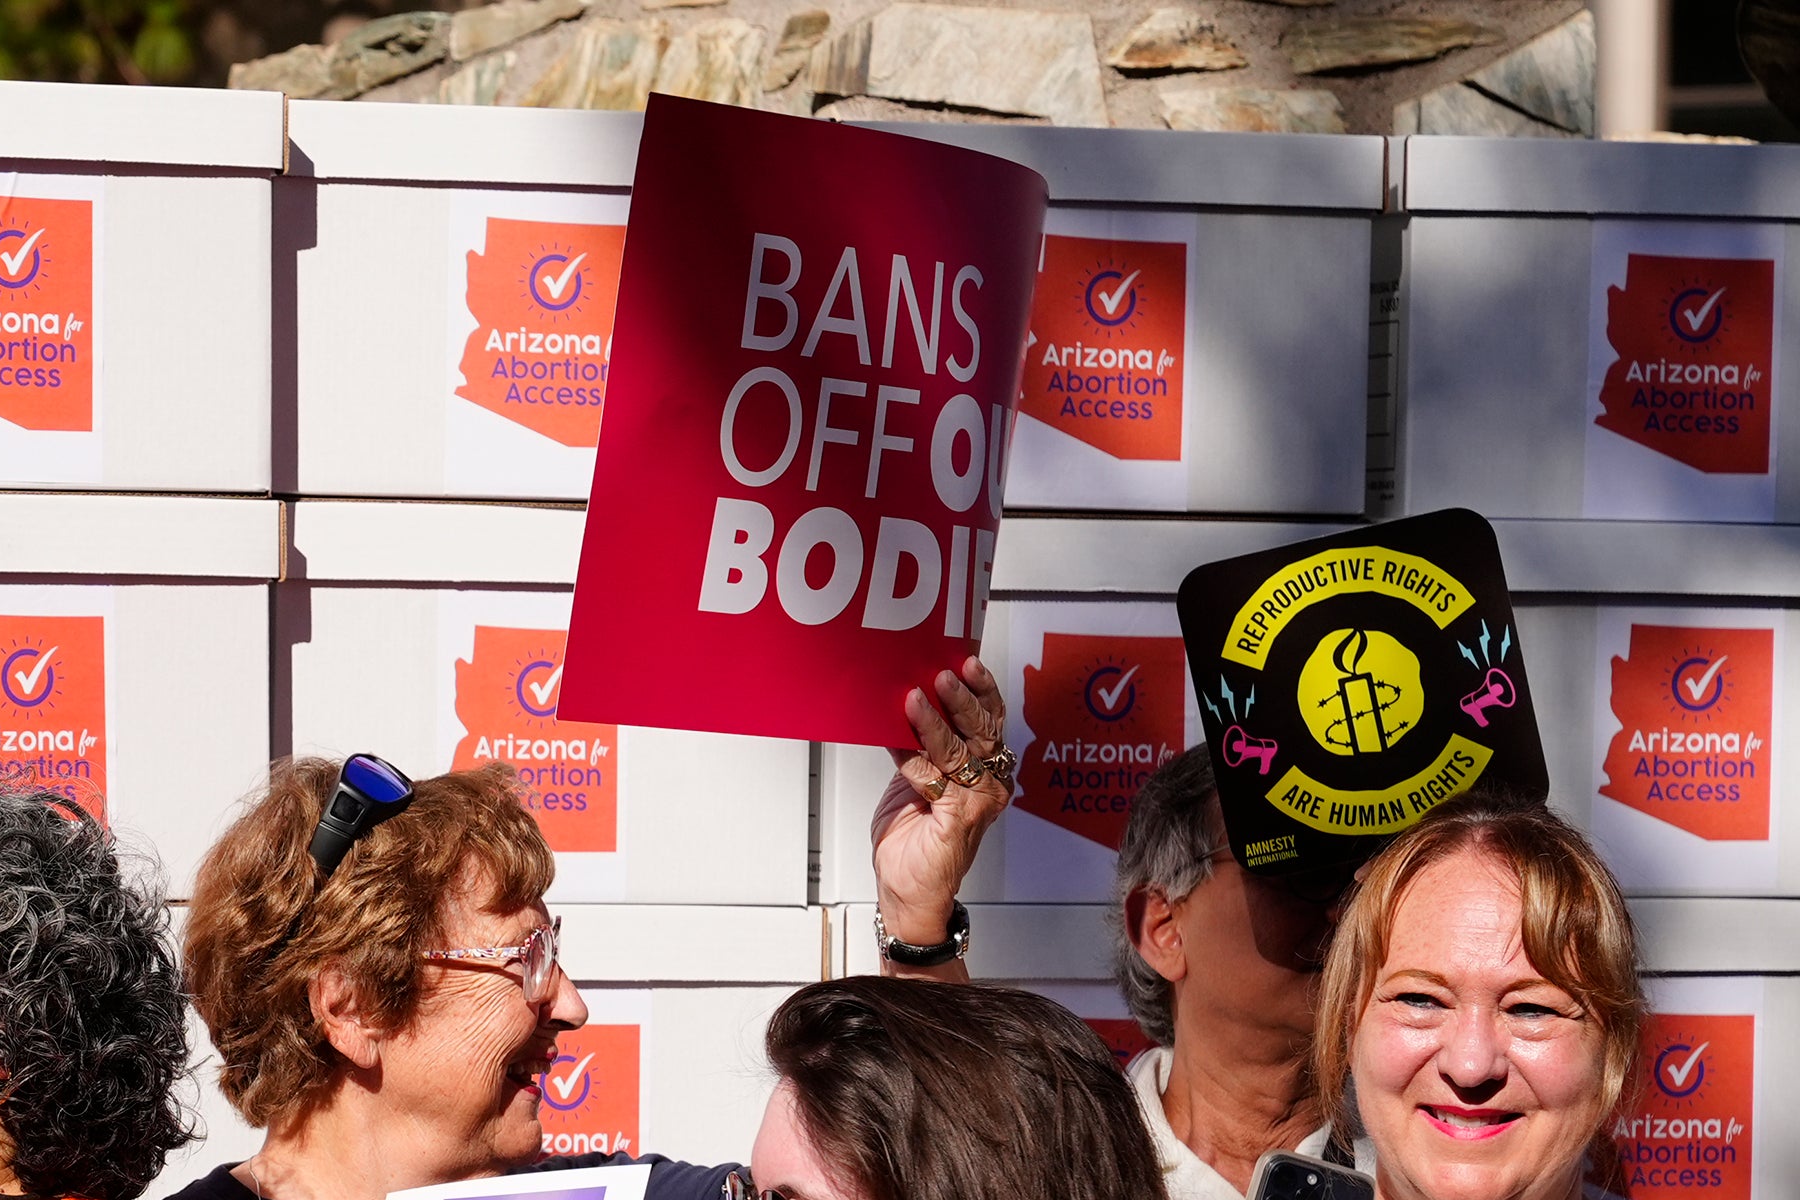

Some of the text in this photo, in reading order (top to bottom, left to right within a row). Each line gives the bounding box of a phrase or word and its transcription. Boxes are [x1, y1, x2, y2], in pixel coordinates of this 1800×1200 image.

[741, 232, 984, 383] BANS
[64, 312, 84, 341] for
[485, 326, 600, 355] Arizona
[1042, 341, 1175, 376] Arizona for
[1048, 370, 1167, 396] Abortion
[1625, 358, 1762, 390] Arizona for
[505, 383, 602, 406] Access
[1060, 396, 1153, 420] Access
[1631, 386, 1755, 410] Abortion
[720, 366, 921, 499] OFF
[1644, 412, 1740, 434] Access
[1236, 558, 1456, 654] REPRODUCTIVE RIGHTS
[78, 728, 97, 757] for
[473, 733, 610, 766] Arizona for
[1042, 738, 1174, 768] Arizona for
[1628, 727, 1763, 759] Arizona for
[1634, 755, 1755, 779] Abortion
[1281, 750, 1475, 827] ARE HUMAN RIGHTS
[1647, 781, 1740, 801] Access
[1061, 792, 1133, 813] Acce
[1246, 834, 1296, 858] AMNESTY
[1248, 849, 1299, 867] INTERNATIONAL
[613, 1131, 631, 1153] for
[1613, 1113, 1744, 1144] Arizona for
[1621, 1141, 1736, 1164] Abortion
[1630, 1166, 1722, 1188] Access
